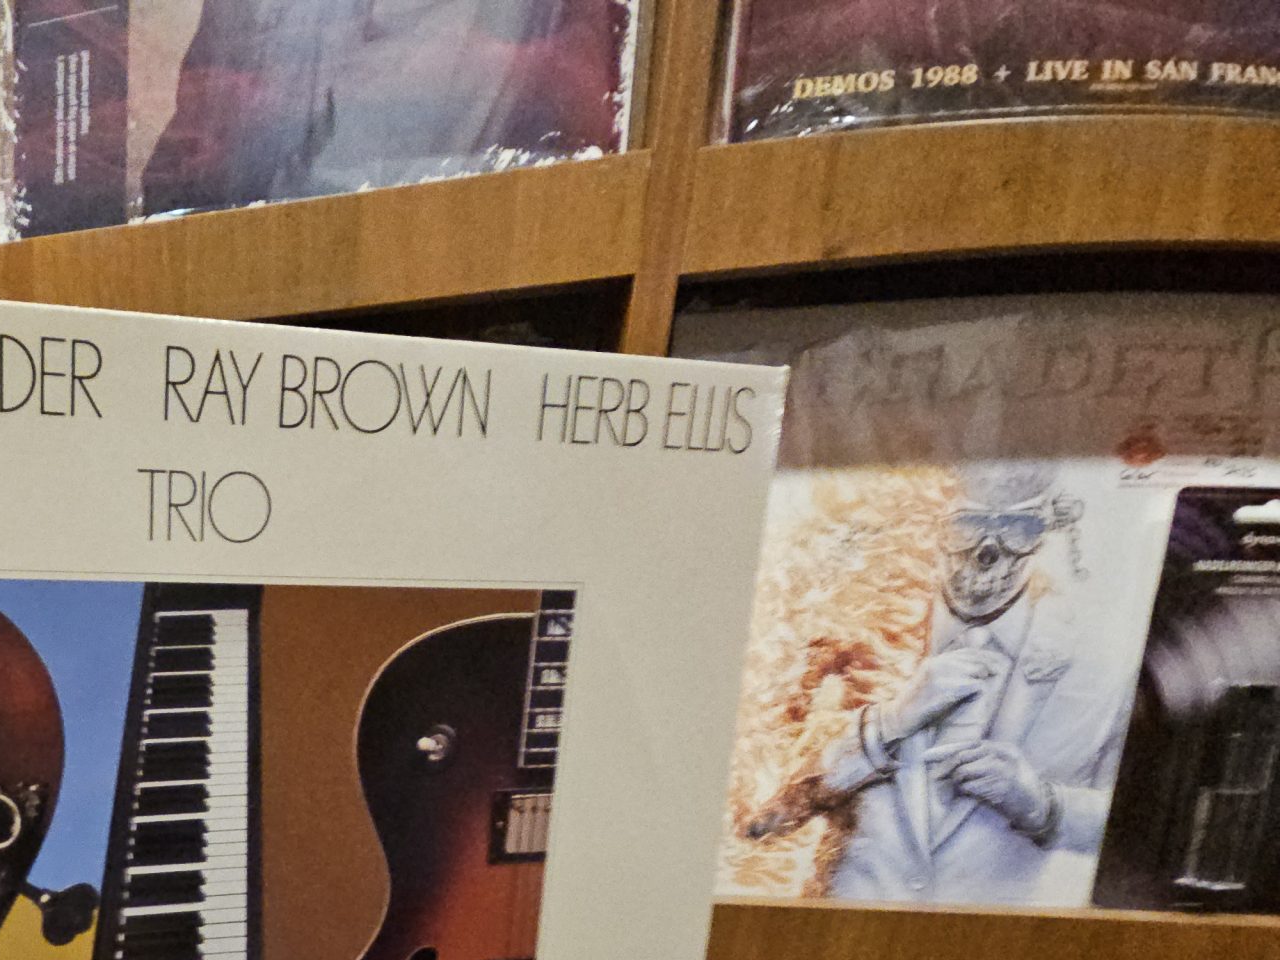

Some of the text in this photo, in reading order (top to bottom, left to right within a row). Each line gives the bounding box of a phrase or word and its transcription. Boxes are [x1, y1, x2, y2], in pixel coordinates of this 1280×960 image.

[793, 70, 896, 98] DEMOS
[911, 63, 979, 89] 1988
[1025, 60, 1089, 82] LIVE
[1100, 59, 1134, 80] IN
[1144, 58, 1198, 81] SAN
[1206, 62, 1280, 85] FRAN
[163, 345, 264, 426] RAY
[278, 354, 492, 438] BROWN
[536, 373, 649, 448] HERB
[661, 382, 758, 455] ELLIS
[136, 468, 272, 544] TRIO
